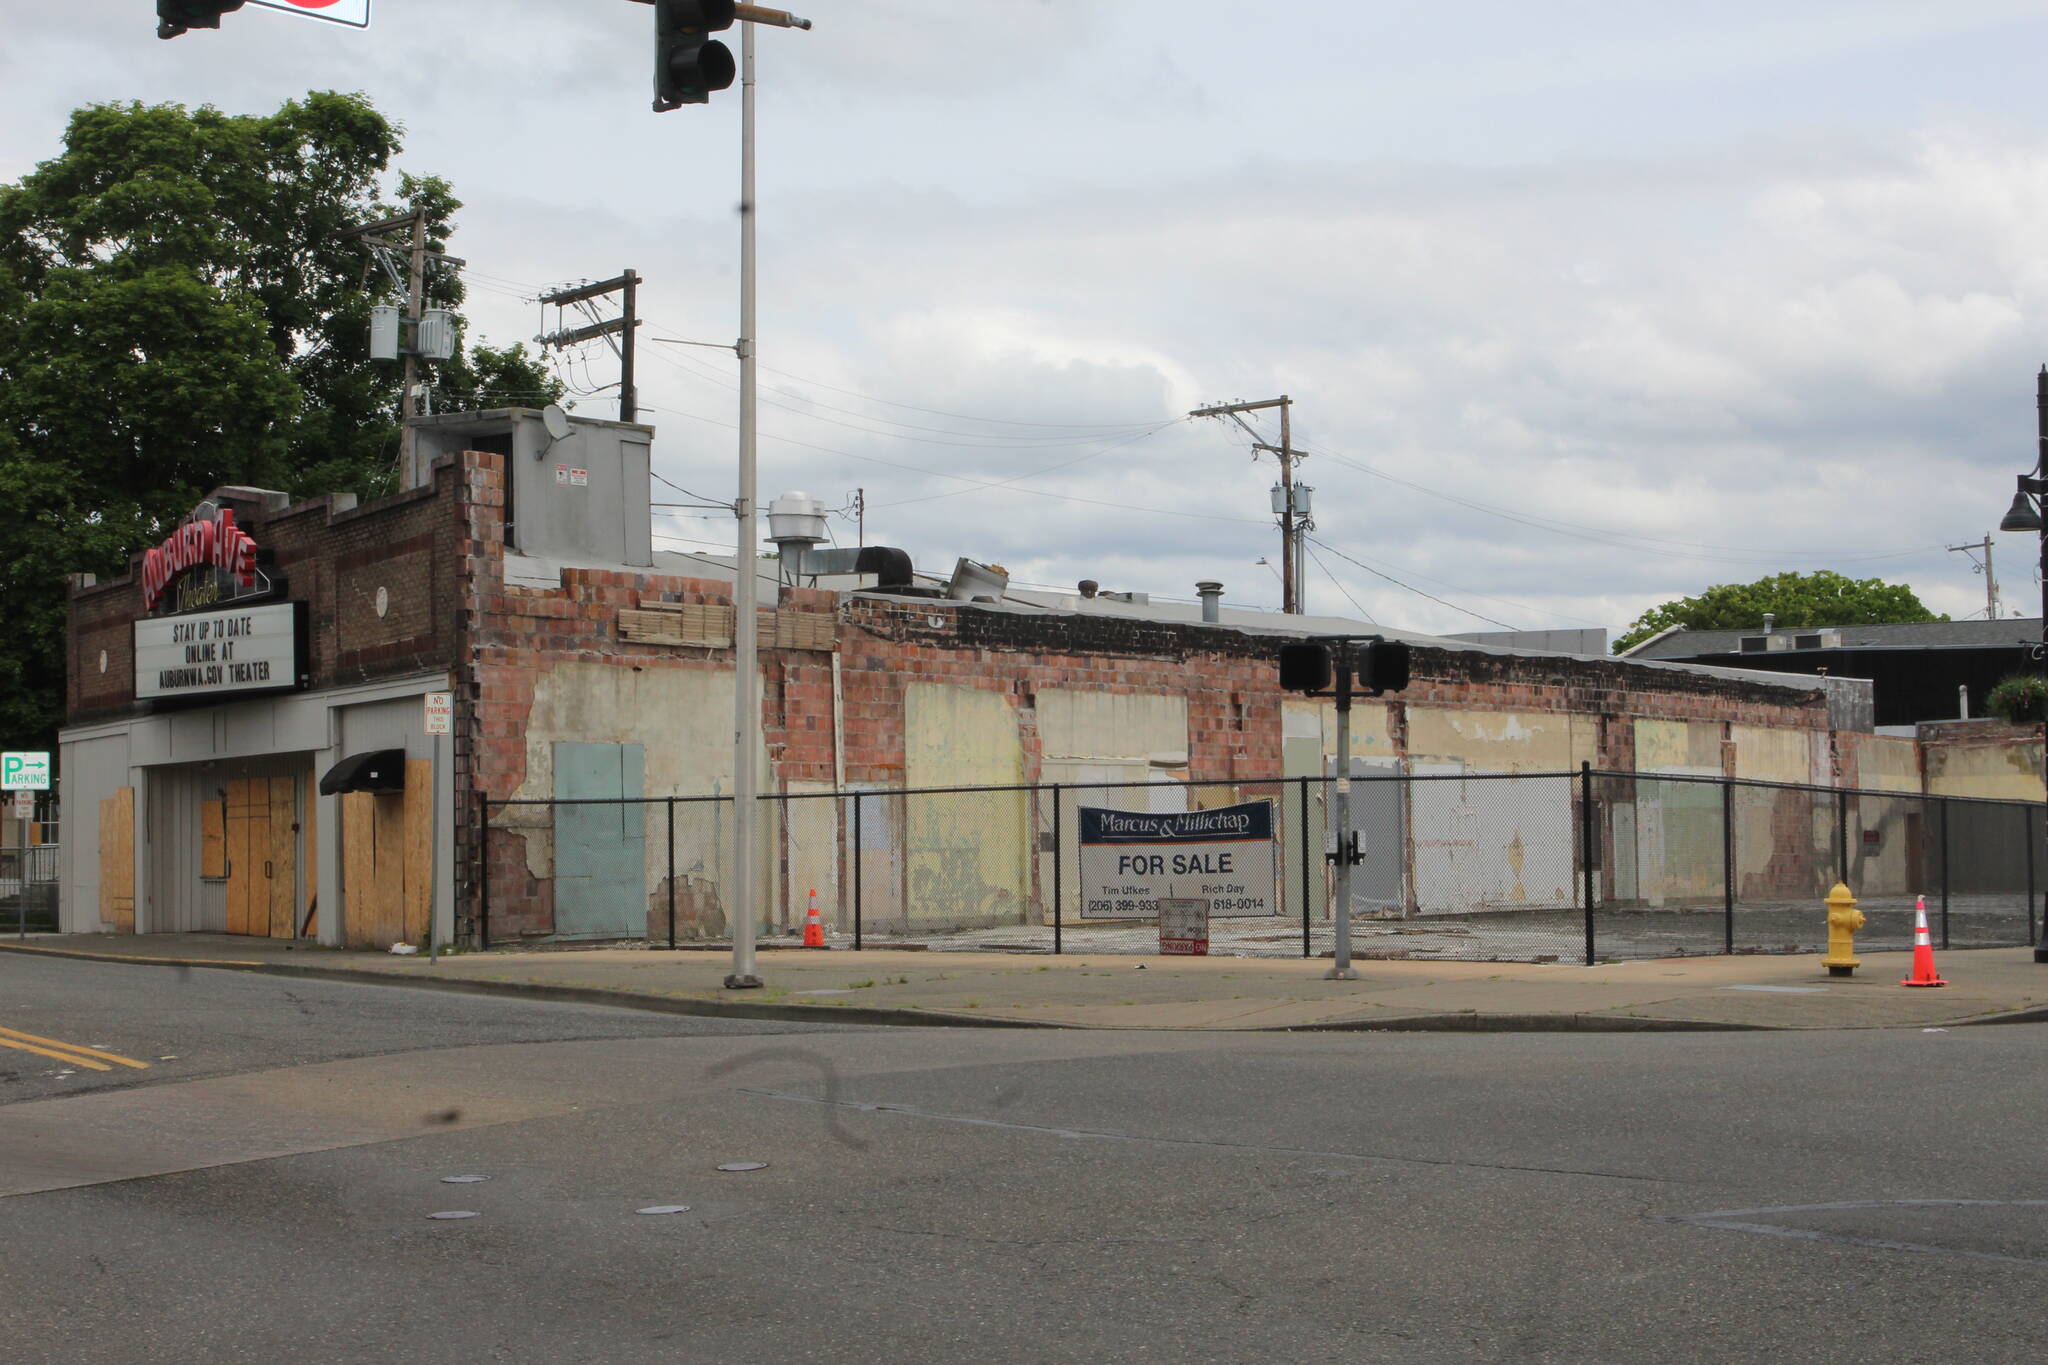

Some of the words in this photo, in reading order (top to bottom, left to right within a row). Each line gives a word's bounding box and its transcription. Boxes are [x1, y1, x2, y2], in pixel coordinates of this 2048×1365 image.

[213, 508, 257, 588] AVE
[173, 622, 195, 643] STAY
[199, 620, 210, 641] UP
[213, 619, 224, 639] TO
[227, 616, 252, 637] DATE
[185, 643, 216, 664] ONLINE
[222, 641, 234, 661] AT
[159, 665, 223, 689] AUBURNWA.GOV
[229, 660, 270, 683] THEATER
[426, 706, 449, 714] PARKING
[433, 696, 444, 705] NO
[5, 757, 47, 784] PARKING
[1100, 813, 1158, 833] Marcus
[1159, 819, 1176, 838] &
[1175, 811, 1250, 833] Millichap
[1118, 854, 1165, 876] FOR
[1172, 852, 1234, 875] SALE
[1102, 886, 1120, 896] Tim
[1201, 884, 1224, 895] Rich
[1226, 884, 1245, 896] Day
[1088, 900, 1112, 912] (206)
[1115, 899, 1160, 911] 399-933
[1213, 898, 1264, 910] 618-0014
